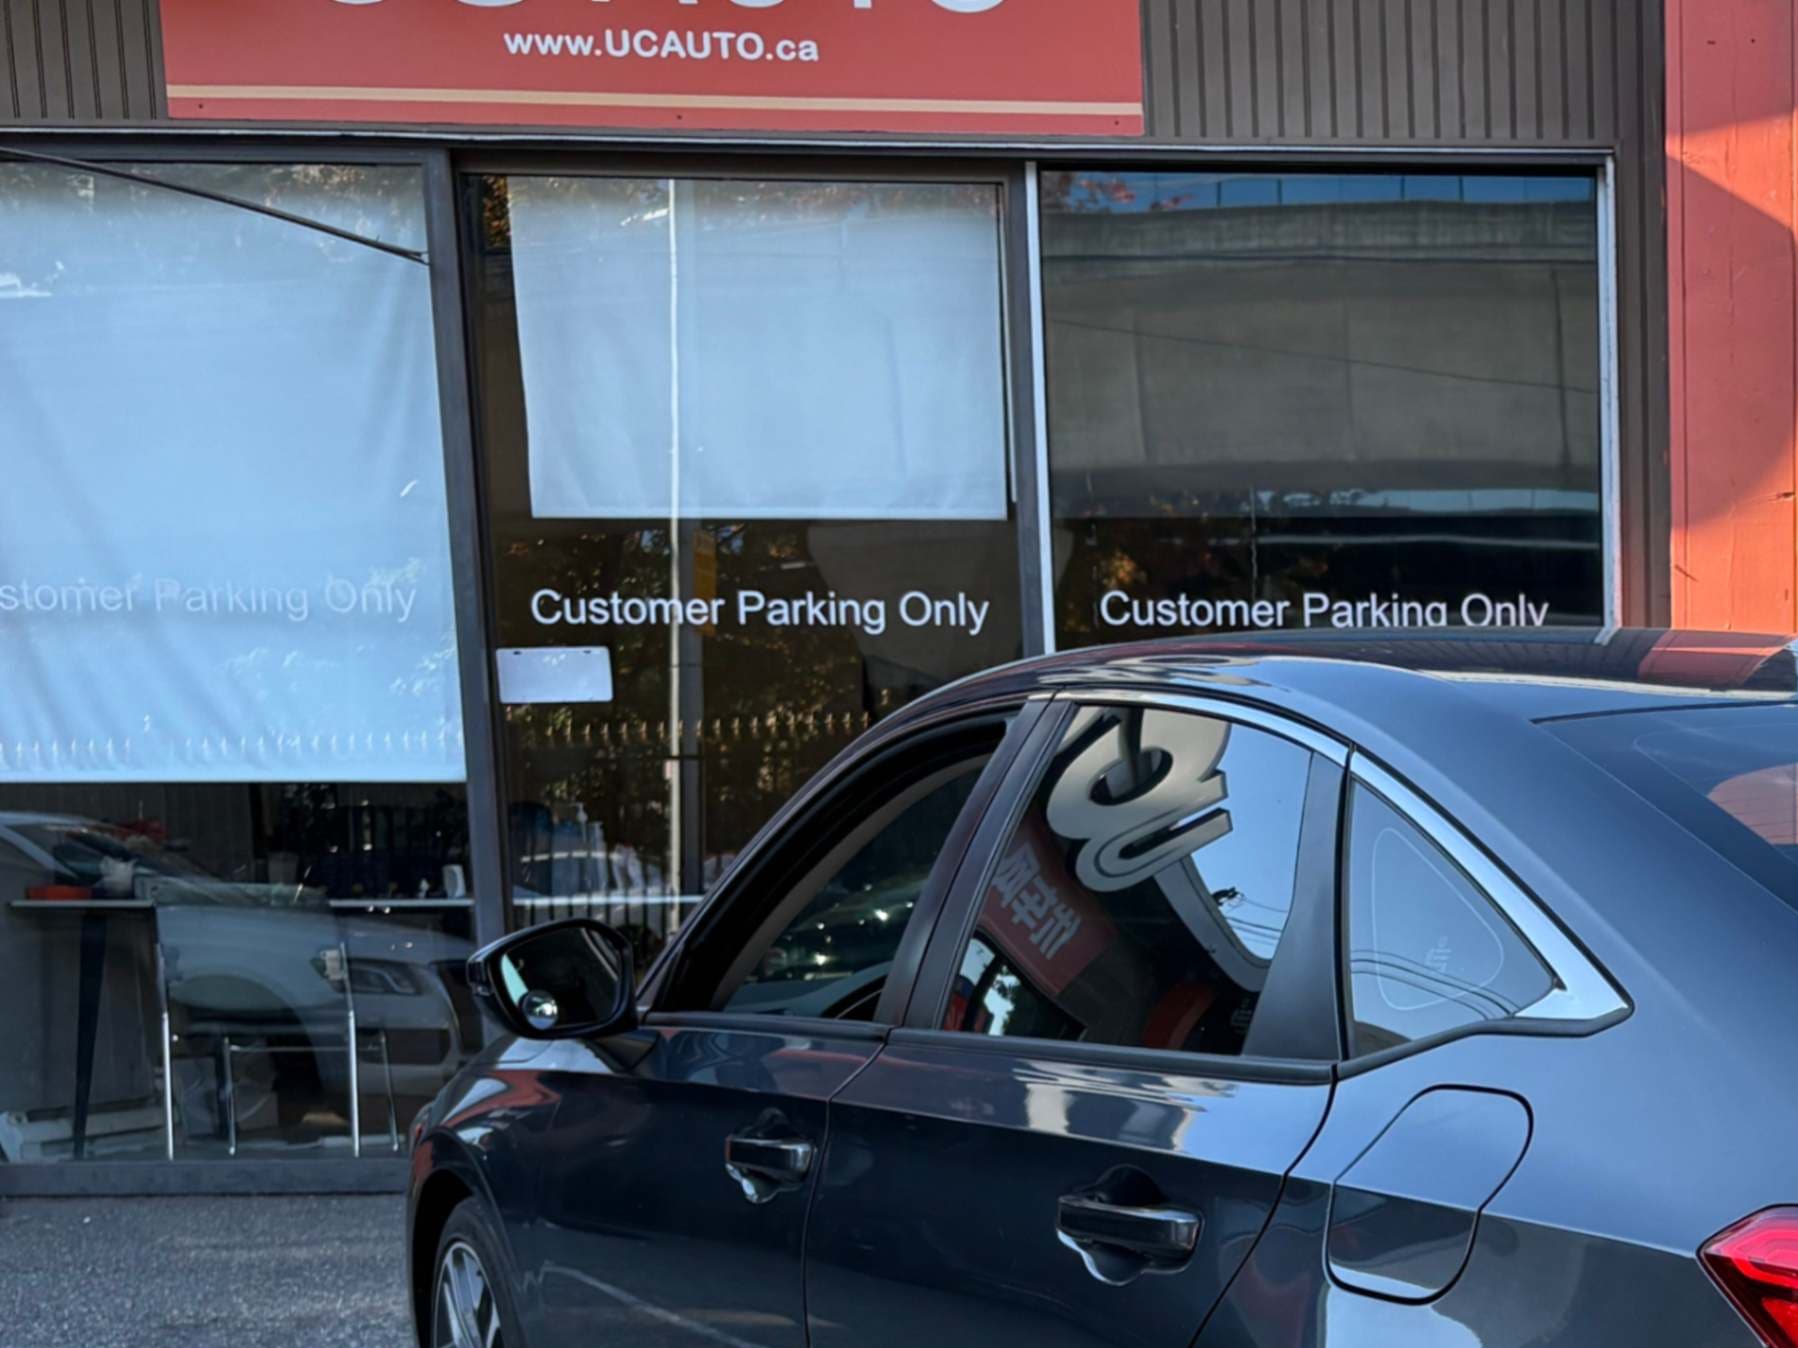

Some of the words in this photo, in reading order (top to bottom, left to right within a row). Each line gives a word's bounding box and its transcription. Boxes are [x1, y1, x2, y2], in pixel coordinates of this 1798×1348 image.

[503, 29, 819, 61] www.UCAUTO.ca
[154, 577, 309, 622] Parking
[324, 576, 417, 623] Only
[531, 587, 724, 626] Customer
[737, 590, 886, 635] Parking
[899, 591, 990, 635] Only
[1100, 589, 1291, 627] Customer
[1302, 592, 1447, 628] Parking
